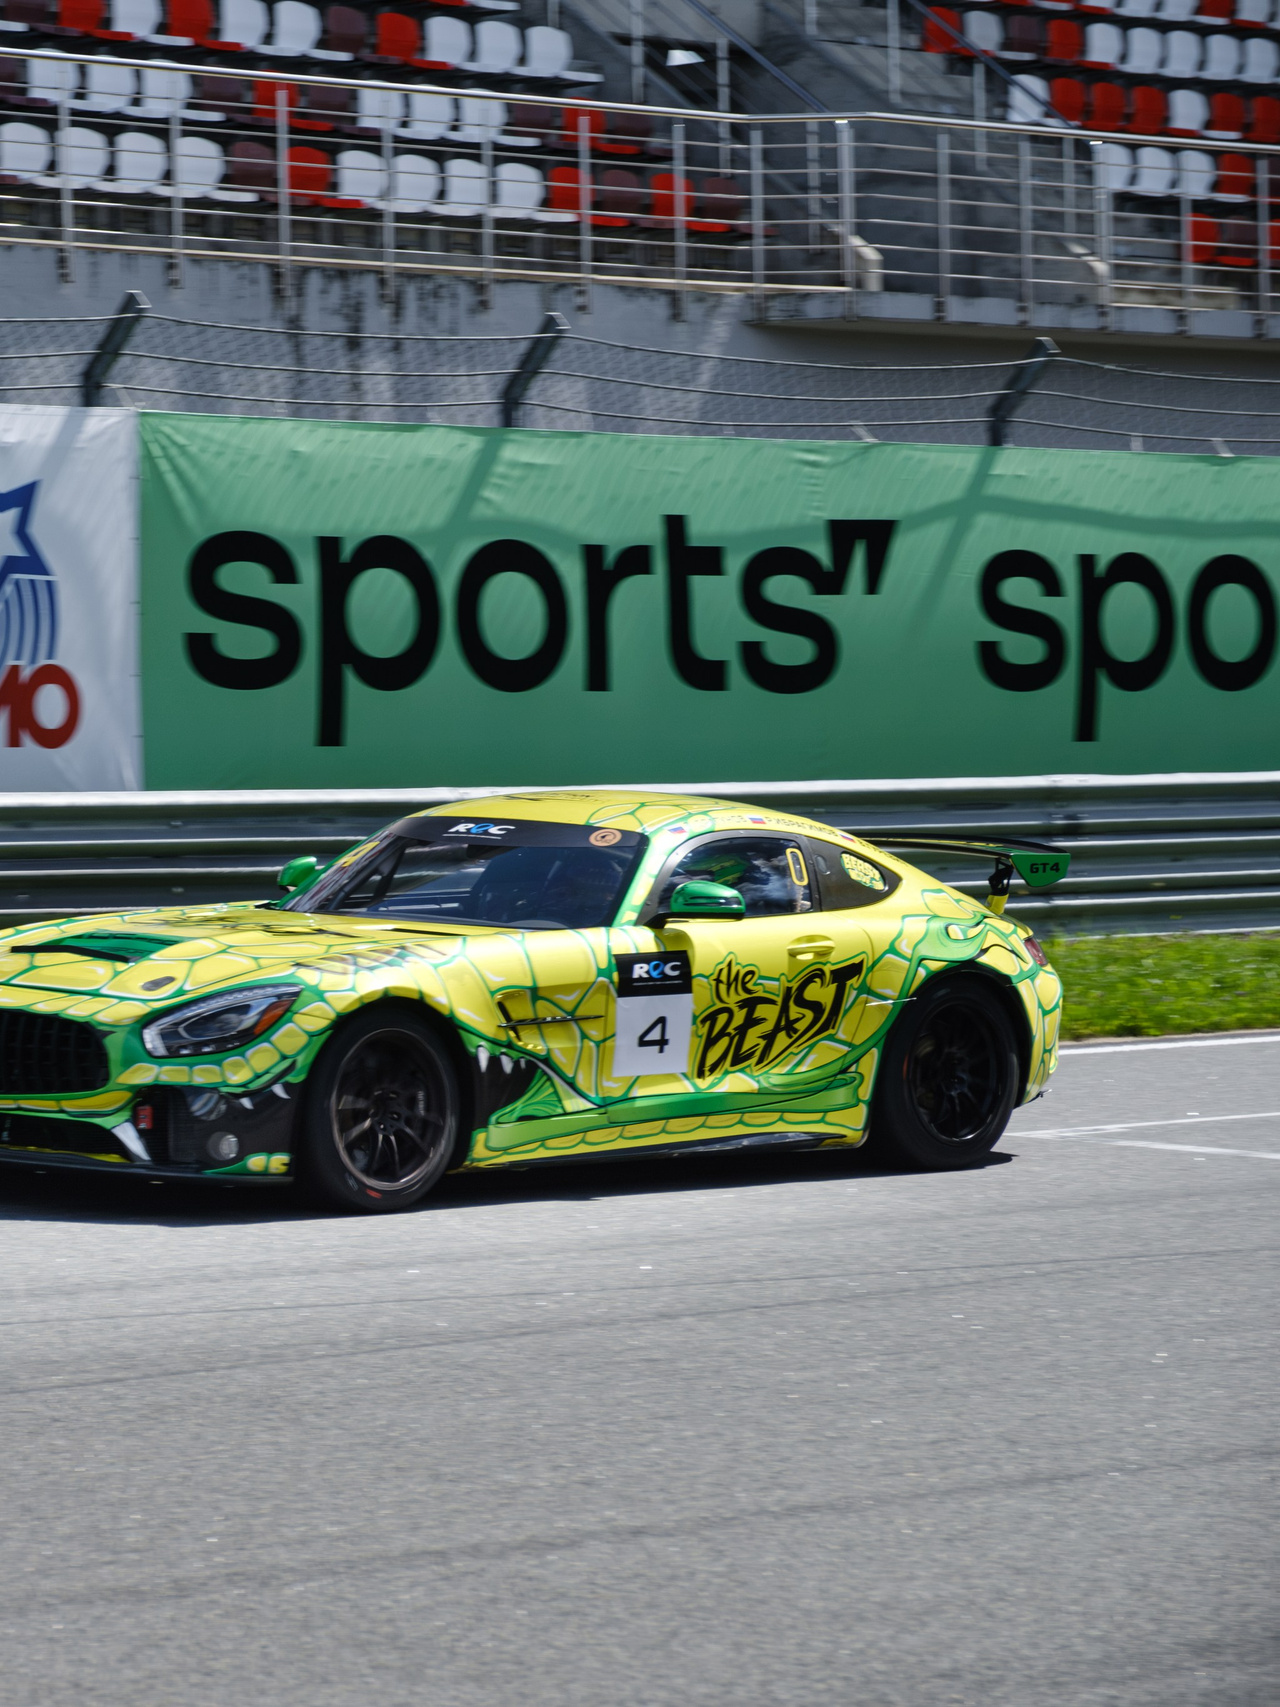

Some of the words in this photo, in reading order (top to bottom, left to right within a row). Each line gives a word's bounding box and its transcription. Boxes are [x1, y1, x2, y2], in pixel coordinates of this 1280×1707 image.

[975, 549, 1280, 742] spo
[1029, 862, 1061, 874] GT4
[712, 959, 758, 1004] the
[637, 1015, 669, 1053] 4
[696, 958, 865, 1080] BEAST
